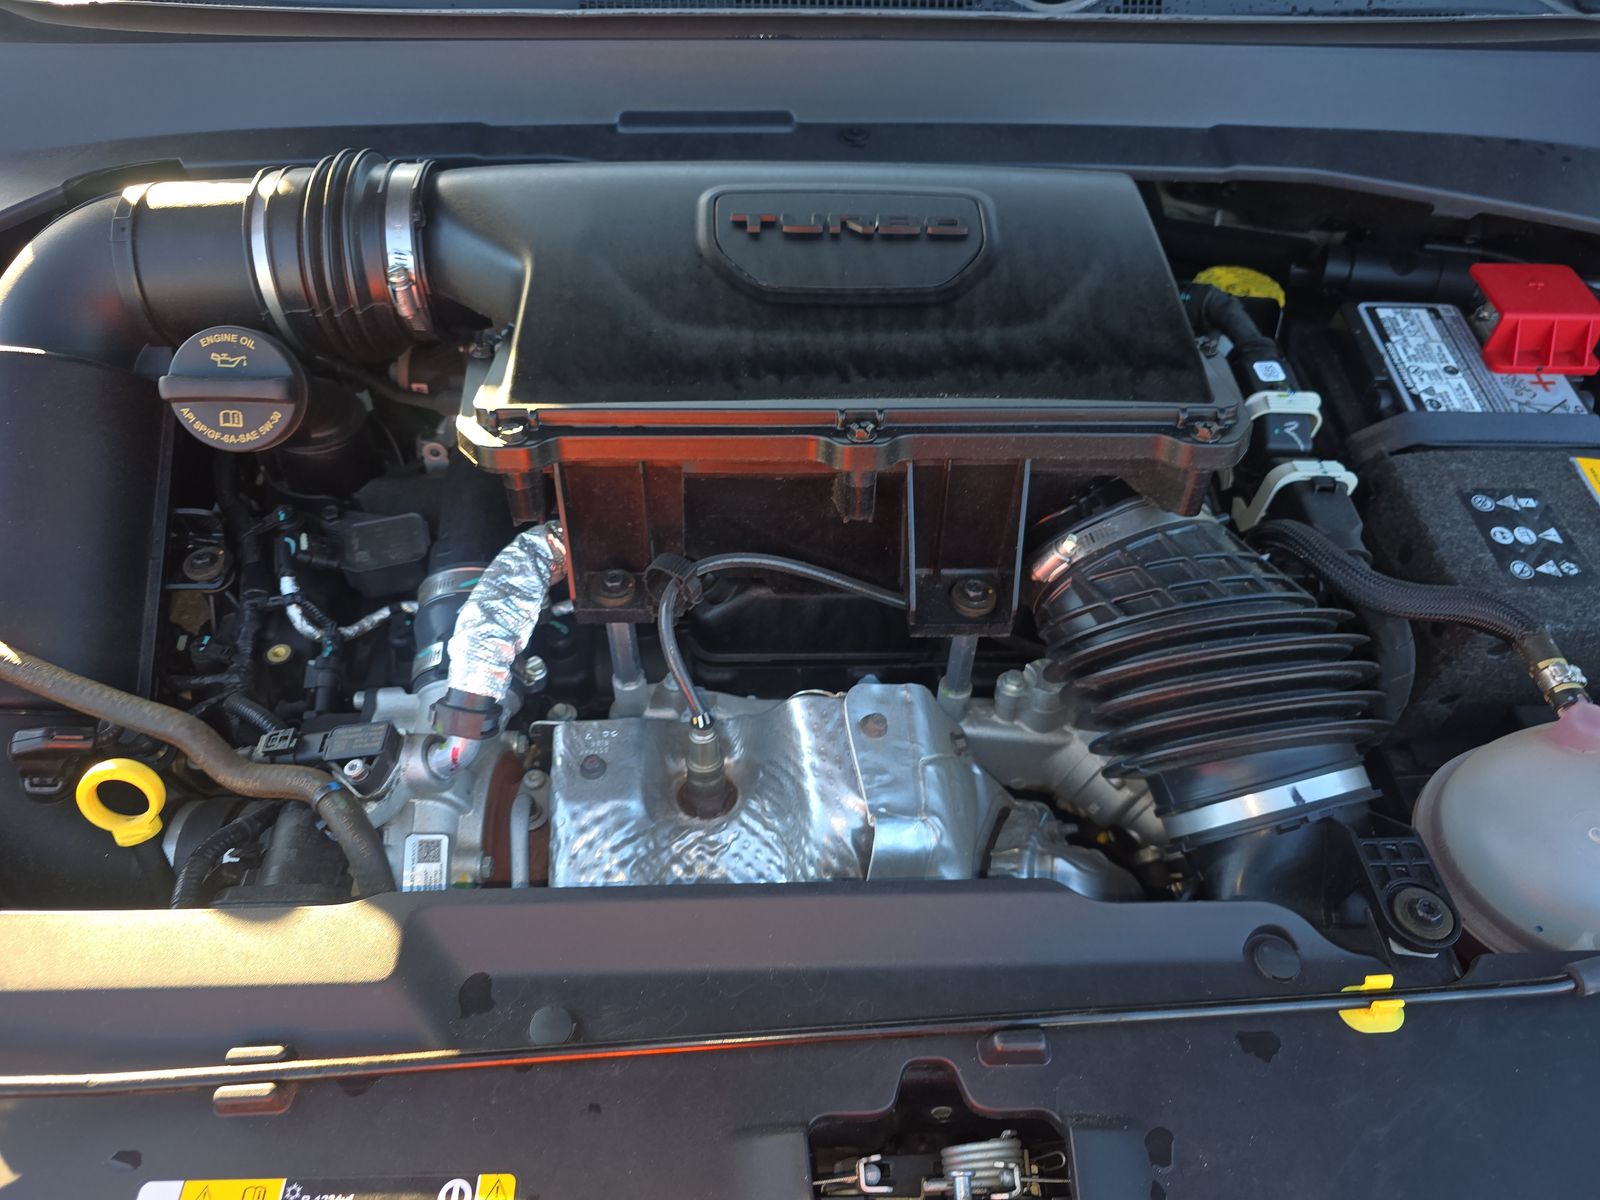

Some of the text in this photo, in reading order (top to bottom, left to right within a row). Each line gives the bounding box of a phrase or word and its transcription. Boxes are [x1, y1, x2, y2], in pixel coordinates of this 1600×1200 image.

[730, 211, 969, 235] TURBO
[199, 333, 256, 350] ENGINE OIL
[180, 407, 196, 423] API
[258, 411, 282, 435] 5W-30
